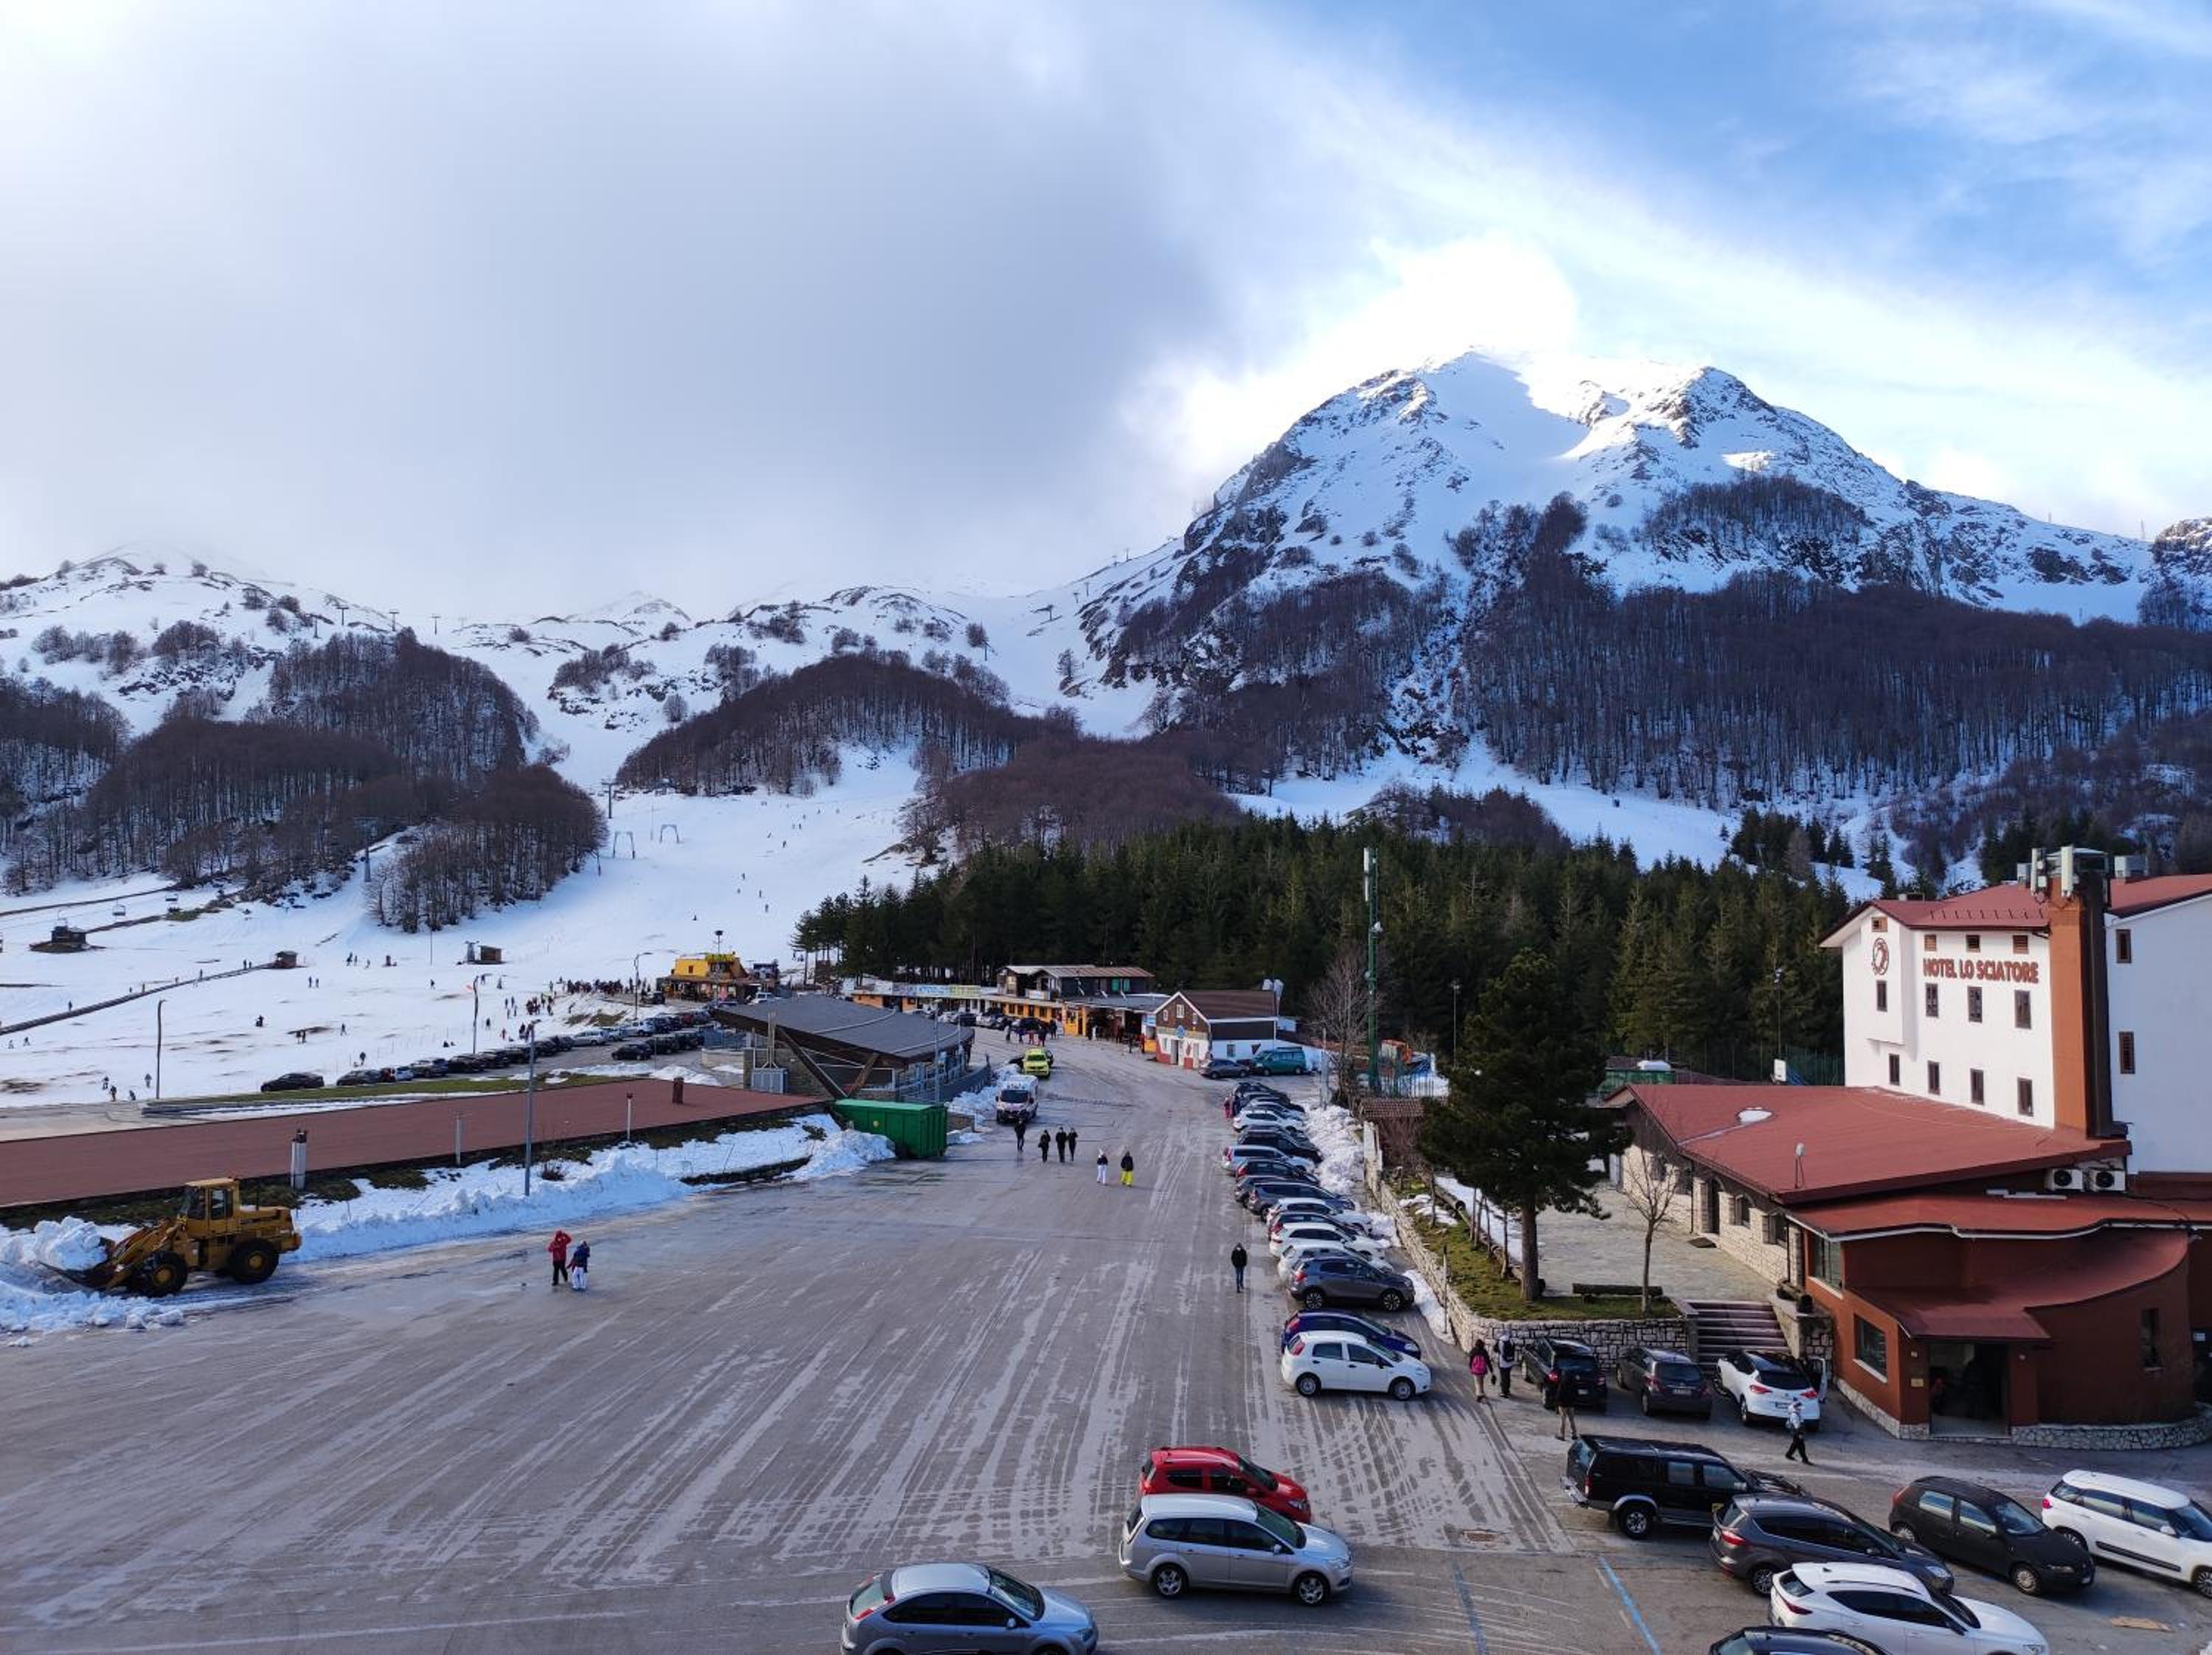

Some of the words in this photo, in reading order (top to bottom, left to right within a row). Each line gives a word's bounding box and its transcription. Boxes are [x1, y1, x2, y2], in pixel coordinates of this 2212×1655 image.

[1923, 958, 1957, 978] HOTEL
[1959, 959, 1975, 979] LO
[1976, 960, 2039, 983] SCIATORE
